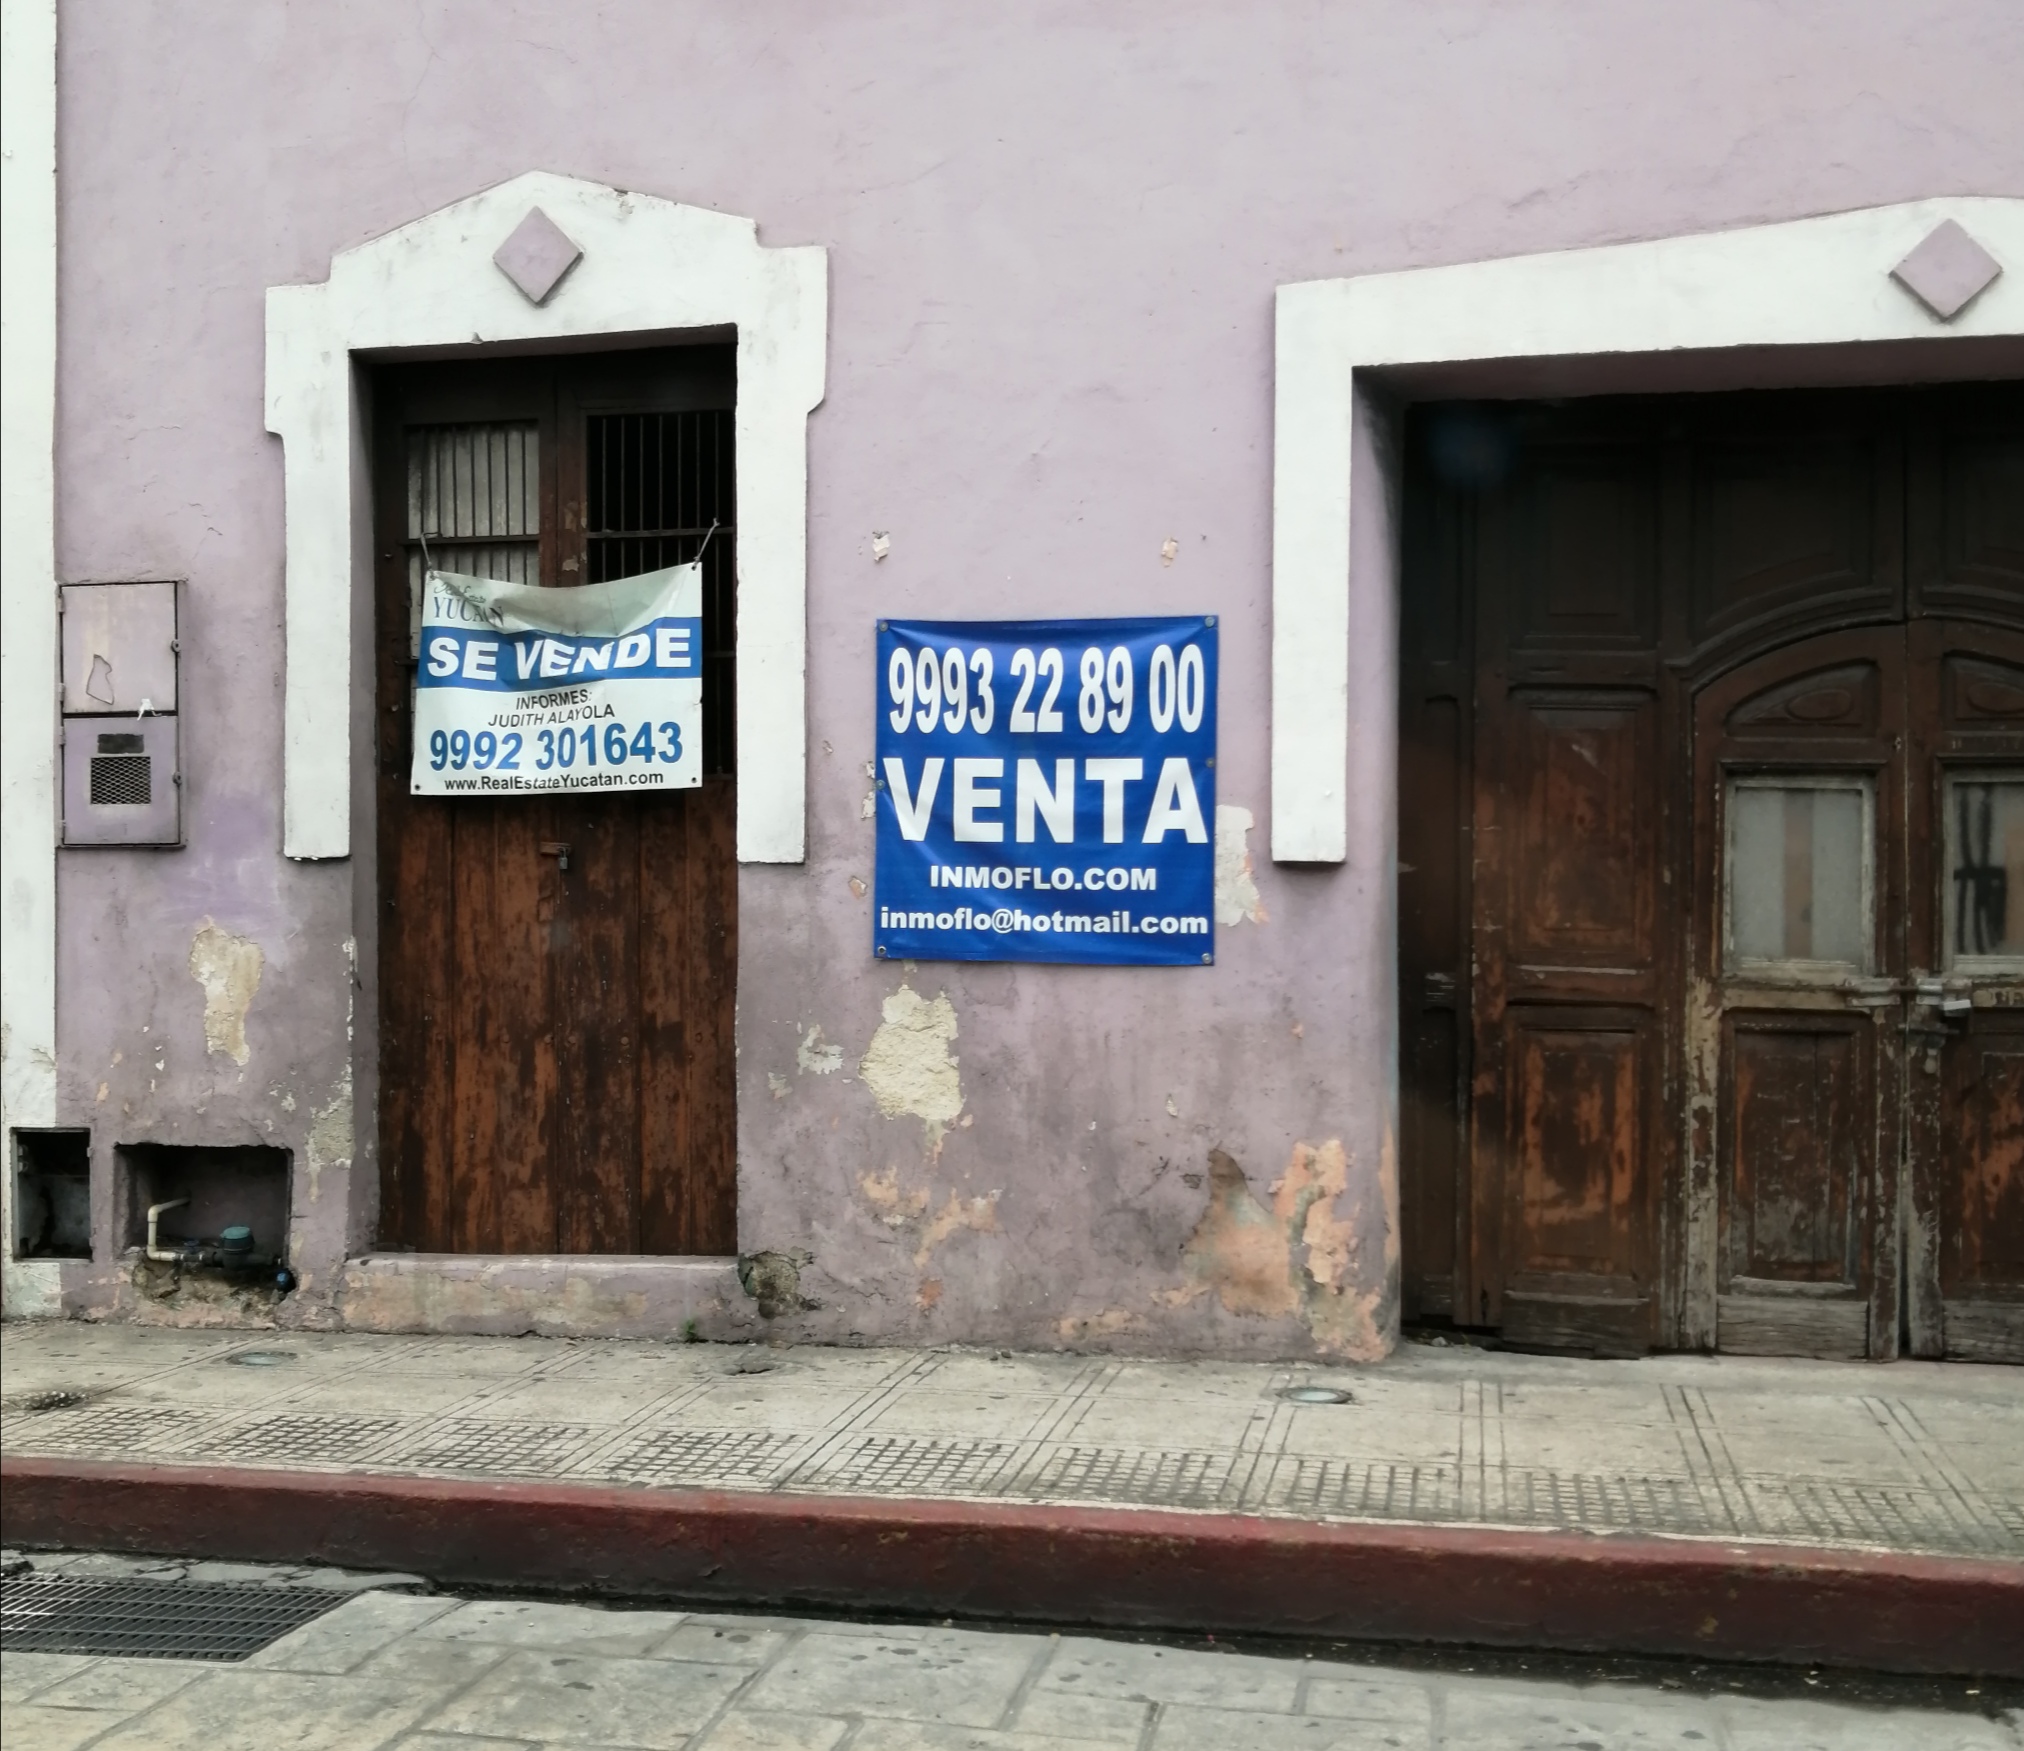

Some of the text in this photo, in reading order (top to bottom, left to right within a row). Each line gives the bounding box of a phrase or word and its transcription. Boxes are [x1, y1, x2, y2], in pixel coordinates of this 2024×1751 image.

[433, 596, 504, 627] YUCAN
[427, 628, 691, 681] SE VENDE
[516, 689, 593, 710] INFORMES:
[889, 644, 1205, 735] 9993 22 89 00
[488, 703, 615, 728] JUDITH ALAYOLA
[429, 721, 683, 771] 9992 301643
[444, 773, 664, 790] www.RealEstateYucatan.com
[882, 757, 1209, 844] VENTA
[930, 865, 1157, 892] INMOFLO.COM
[880, 907, 1209, 934] inmoflo@hotmail.com
